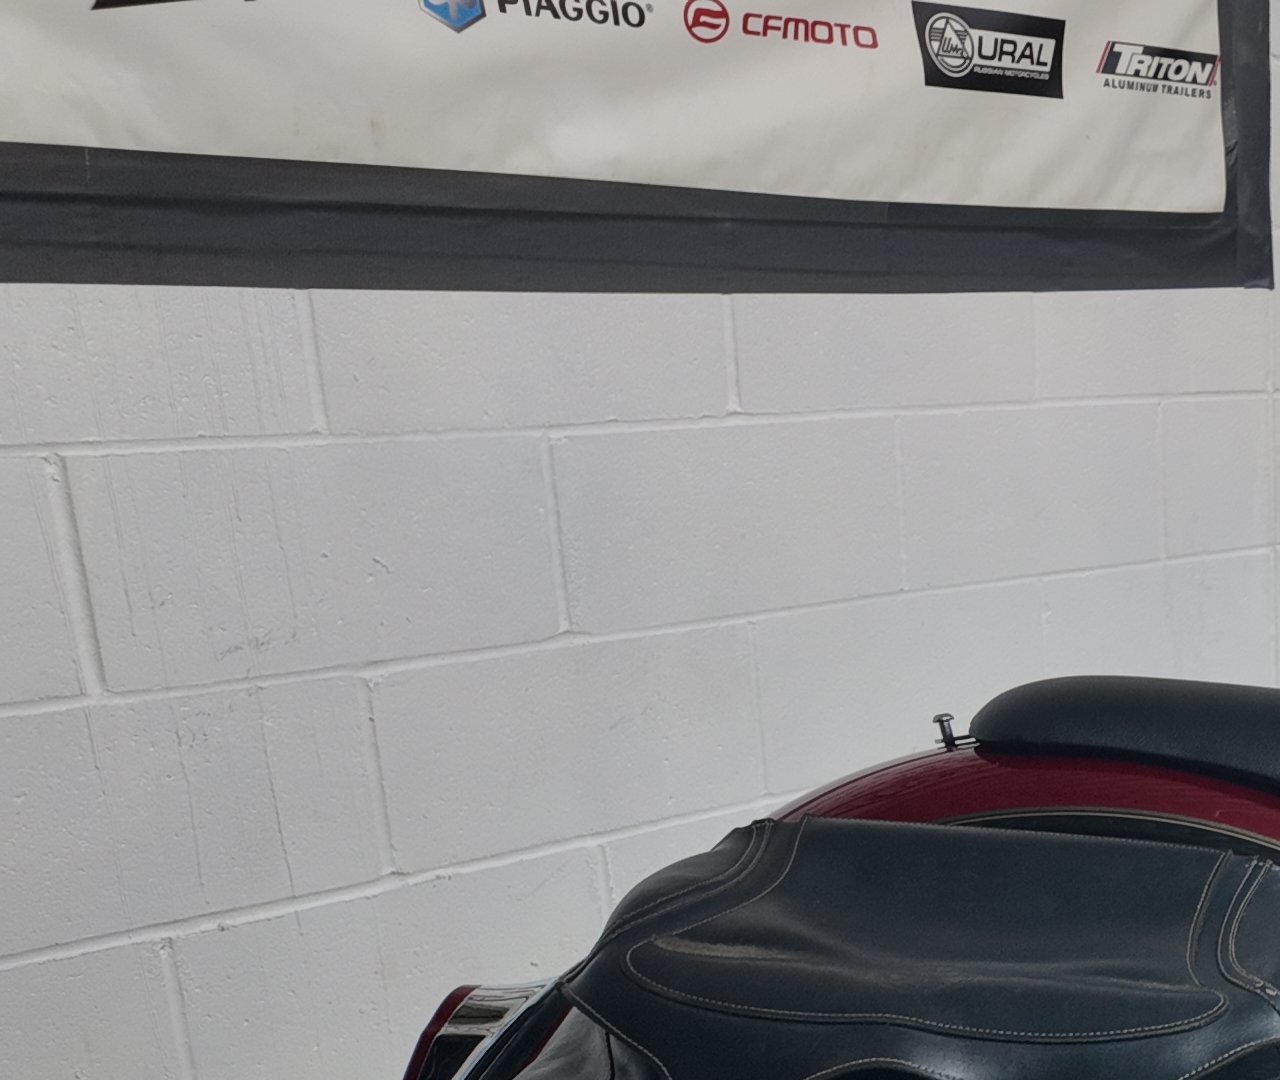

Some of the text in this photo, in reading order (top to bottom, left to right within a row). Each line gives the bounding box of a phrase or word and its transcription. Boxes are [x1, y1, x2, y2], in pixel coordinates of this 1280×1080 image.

[742, 12, 880, 50] CFMOTO
[977, 35, 1048, 67] URAL
[1112, 43, 1214, 84] TRITON
[1103, 78, 1212, 100] ALUMINUM TRAILERS
